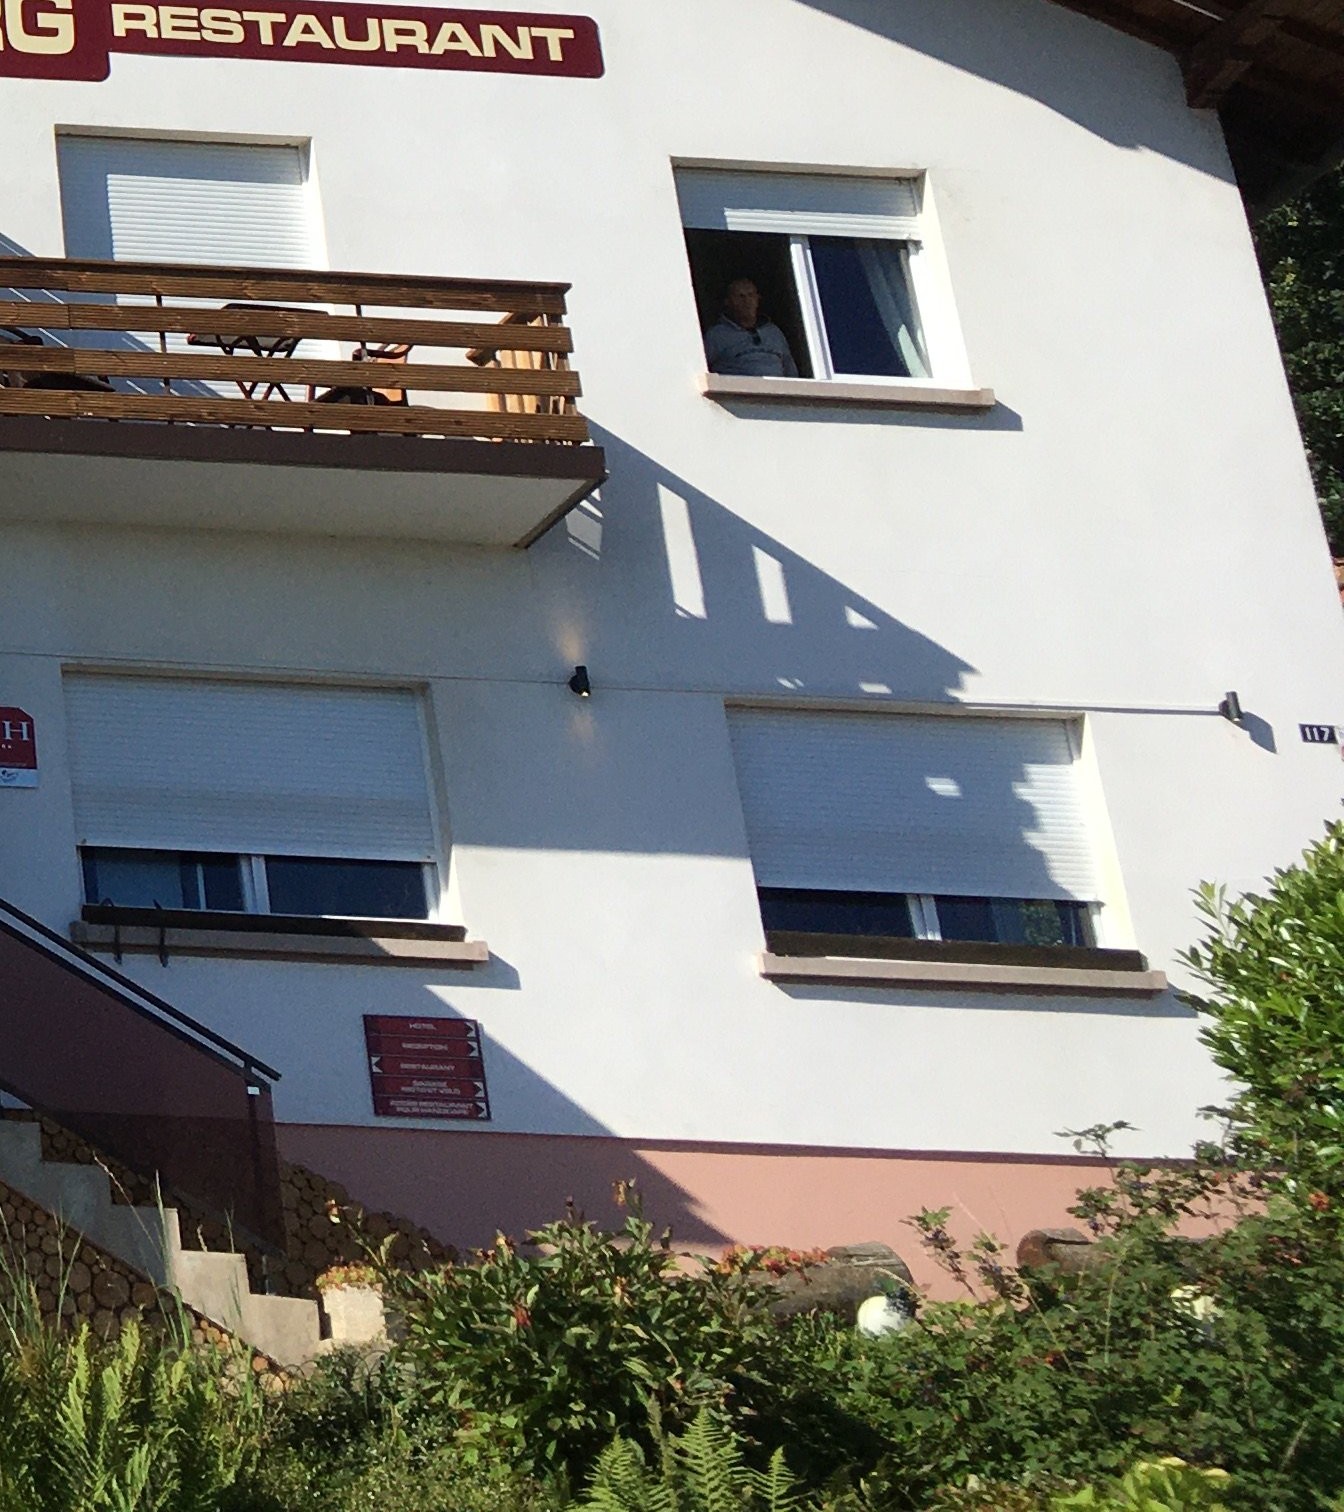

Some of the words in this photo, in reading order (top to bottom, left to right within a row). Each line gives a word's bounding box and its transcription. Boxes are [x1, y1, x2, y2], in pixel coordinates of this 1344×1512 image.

[111, 2, 575, 62] RESTAURANT
[1, 720, 31, 742] H
[1305, 726, 1330, 741] 117
